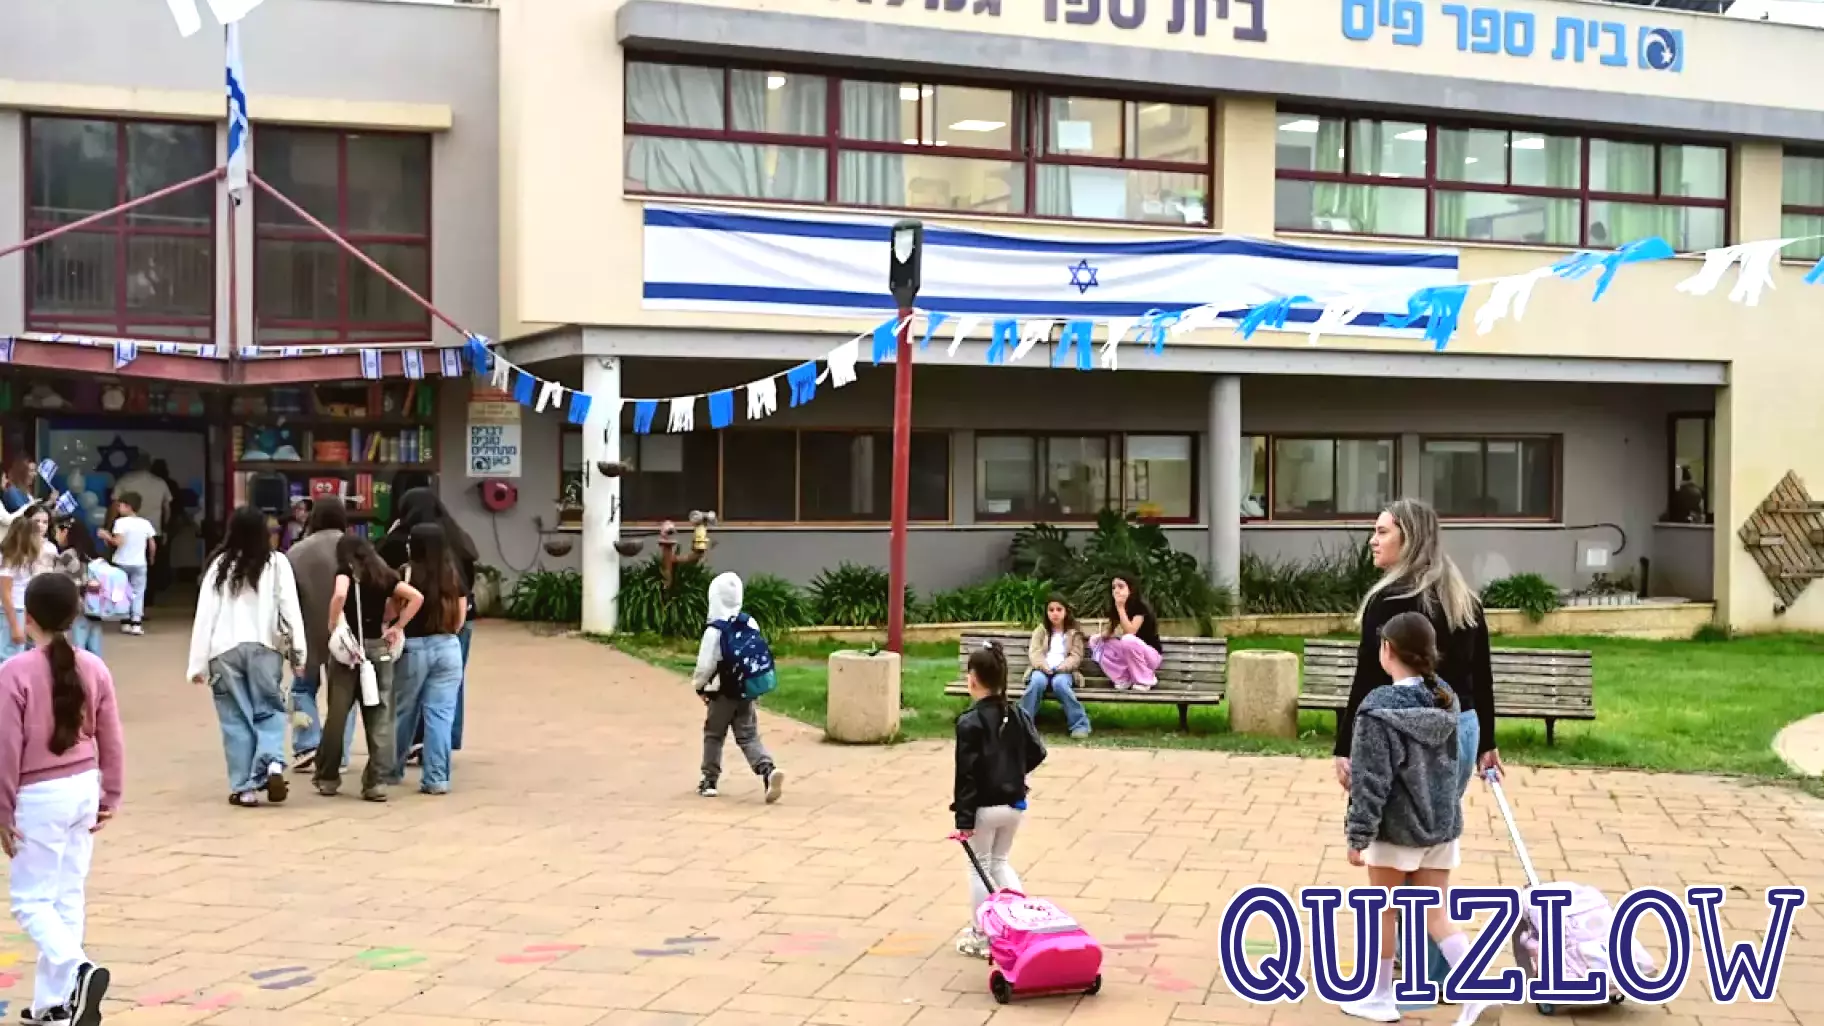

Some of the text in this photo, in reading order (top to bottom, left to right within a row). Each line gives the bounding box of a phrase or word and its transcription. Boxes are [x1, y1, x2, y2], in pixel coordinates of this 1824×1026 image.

[1168, 0, 1267, 42] בית
[1342, 0, 1628, 66] בית ספר פיס
[472, 426, 503, 435] דברים
[472, 444, 517, 455] מתחילים
